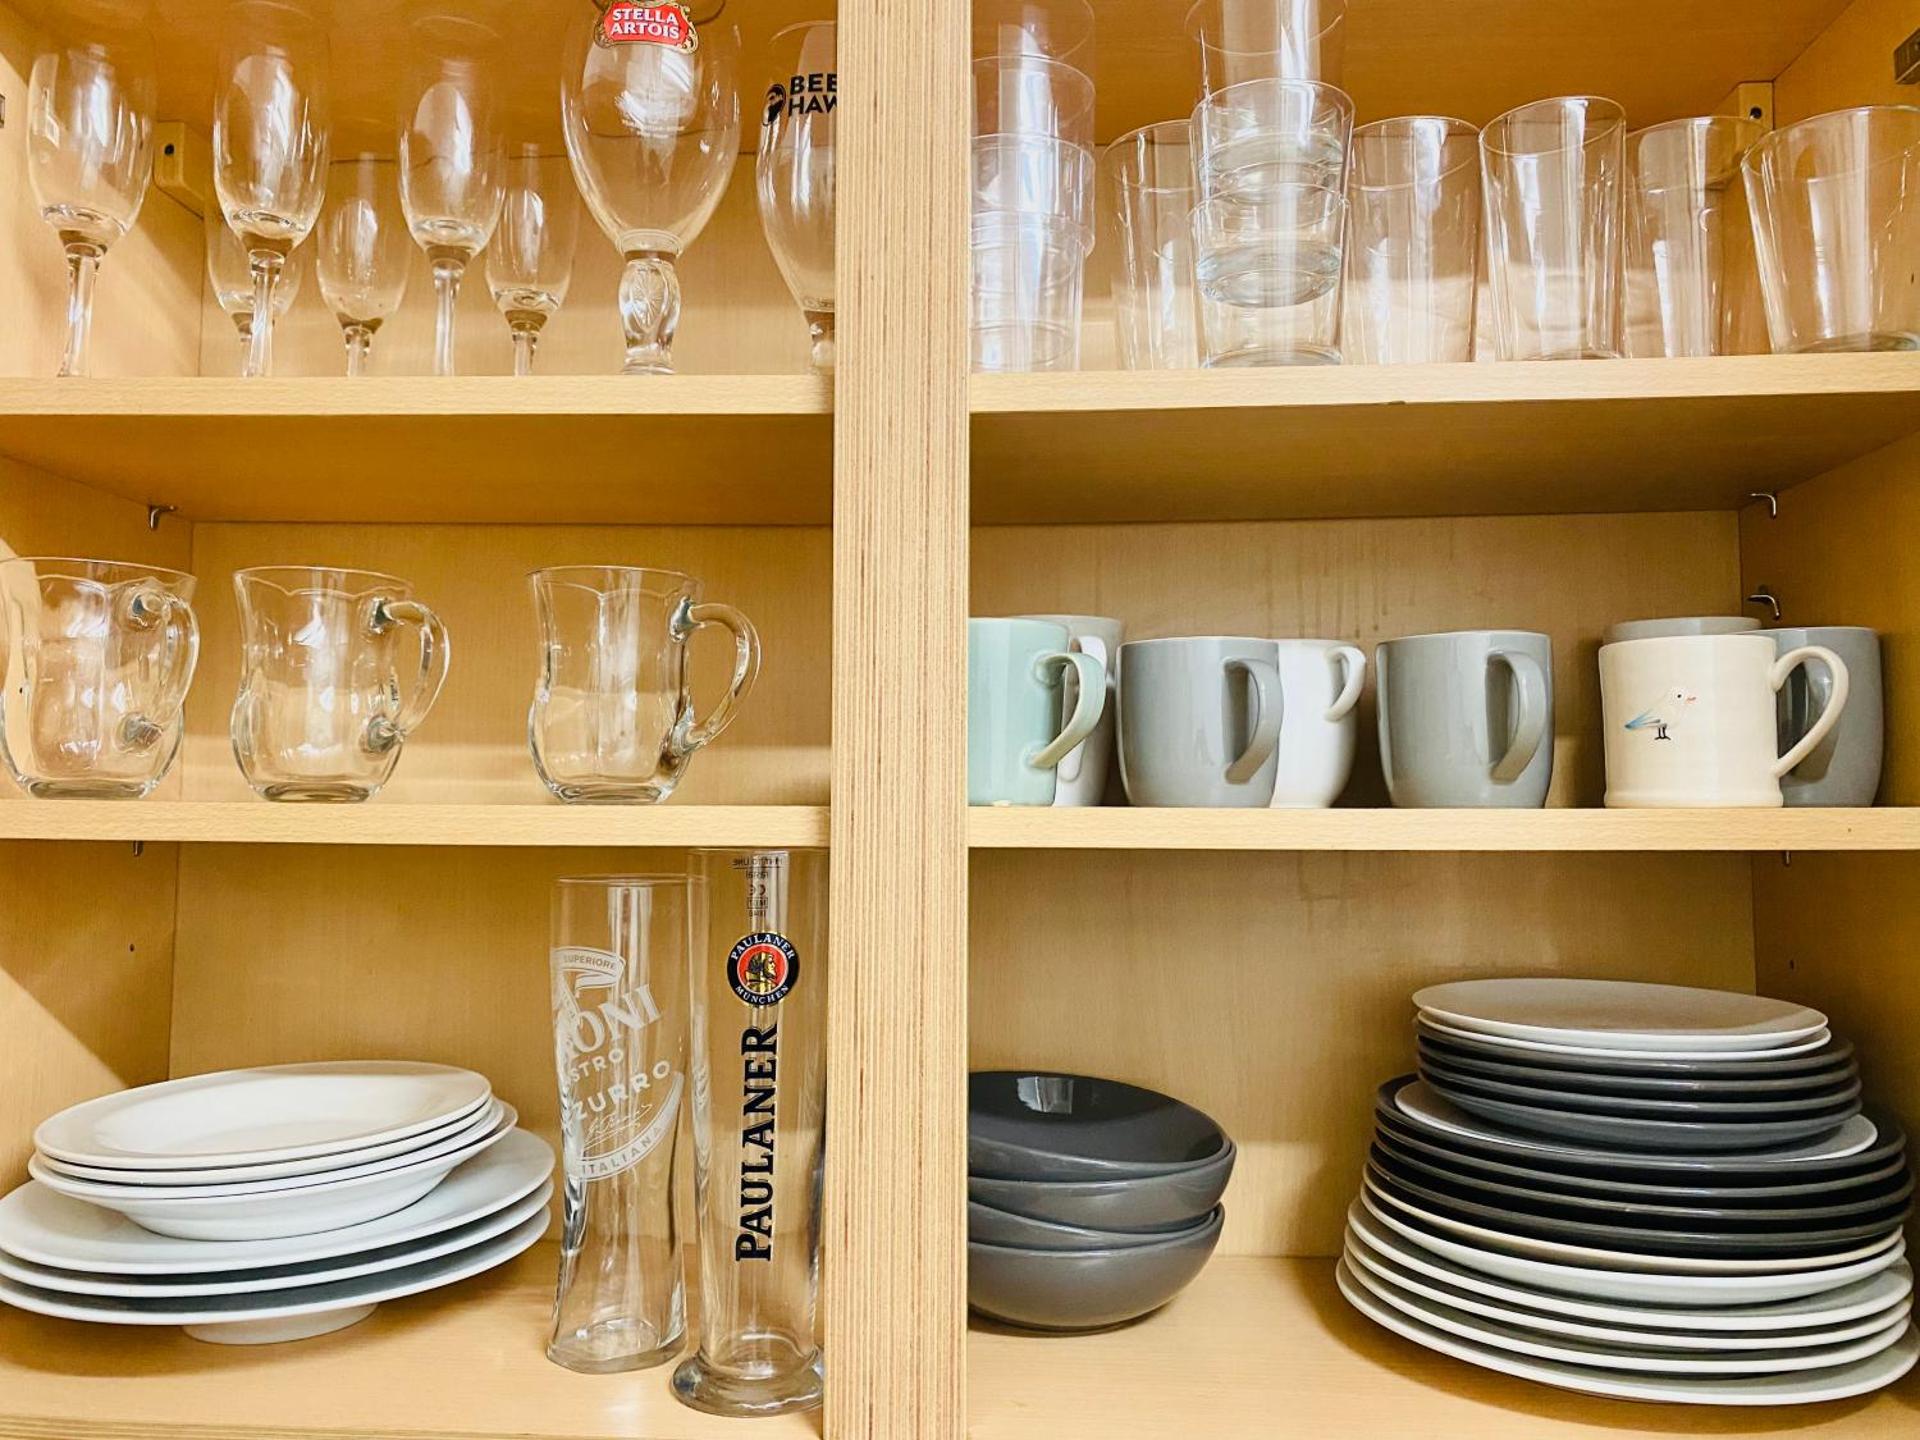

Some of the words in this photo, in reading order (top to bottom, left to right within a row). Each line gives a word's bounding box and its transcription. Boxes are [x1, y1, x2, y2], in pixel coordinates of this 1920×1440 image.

[612, 8, 679, 26] STELLA
[610, 22, 680, 40] ARTOIS
[790, 73, 837, 95] BEE
[788, 94, 837, 117] HAW
[730, 934, 796, 960] PAULANER
[572, 983, 661, 1053] ONI
[570, 1047, 625, 1083] STRO
[571, 1060, 670, 1121] ZURRO
[735, 1023, 778, 1262] PAULANER
